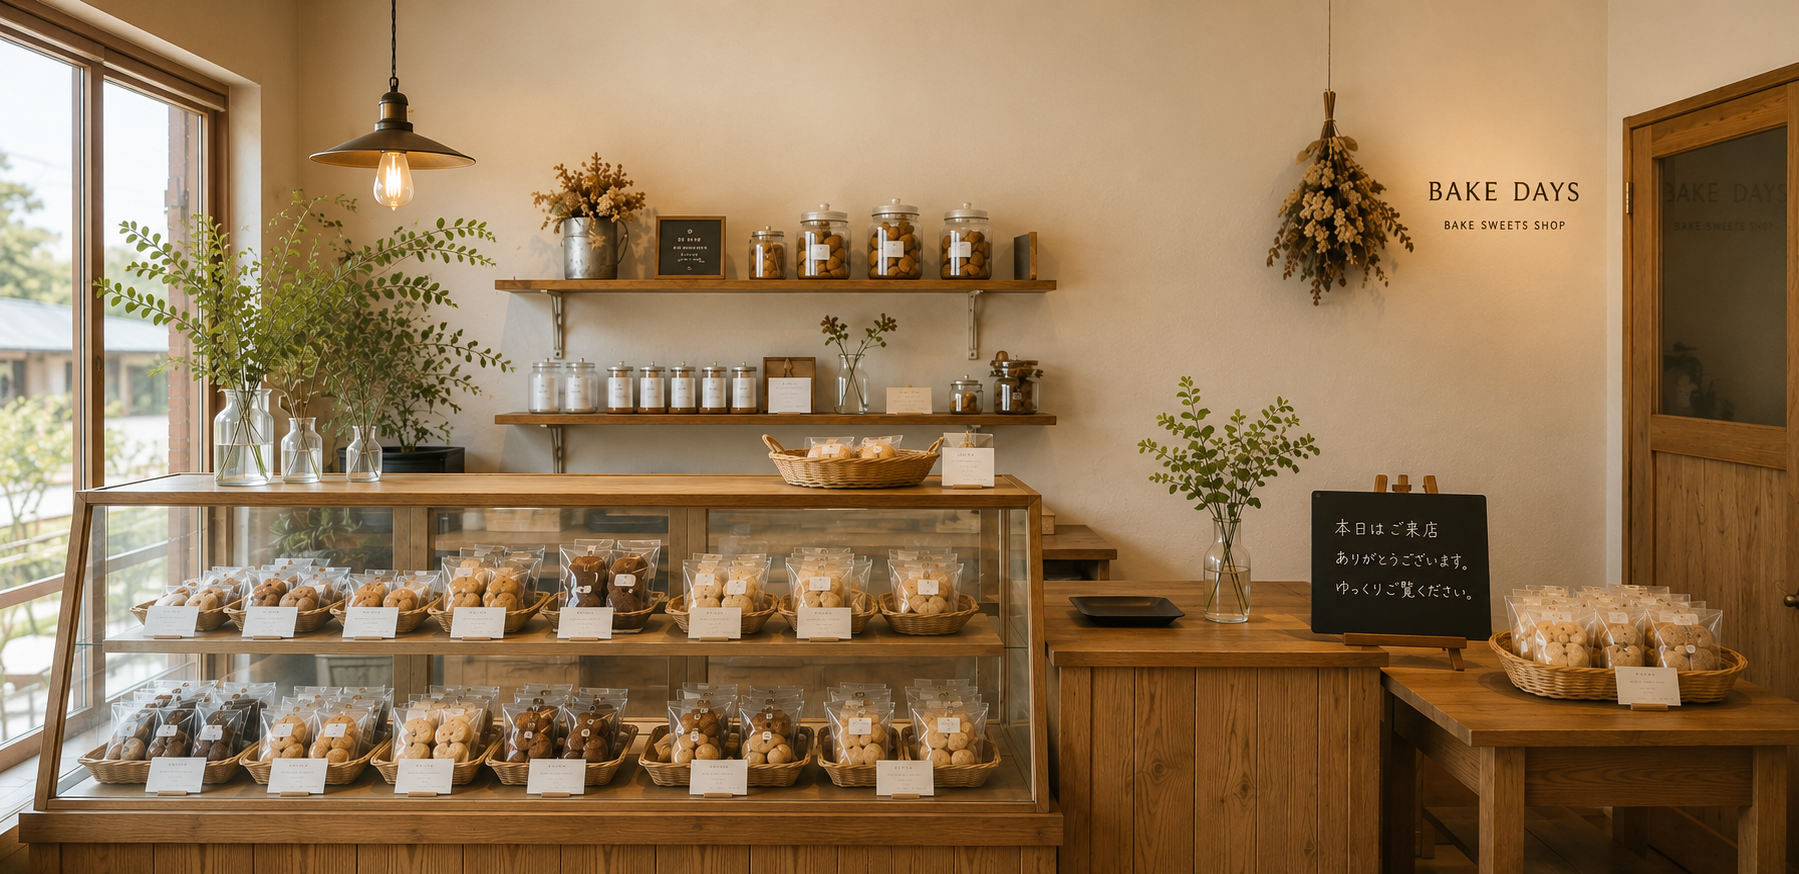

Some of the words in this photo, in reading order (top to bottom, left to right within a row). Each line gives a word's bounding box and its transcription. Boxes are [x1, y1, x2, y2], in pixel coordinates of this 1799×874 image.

[1429, 181, 1498, 202] BAKE
[1513, 181, 1579, 202] DAYS
[1733, 183, 1787, 204] DAYS
[1444, 220, 1475, 230] BAKE
[1481, 220, 1528, 230] SWEETS
[1534, 220, 1565, 230] SHOP
[1674, 221, 1701, 231] BAKE
[1335, 518, 1438, 538] 本日はご来店
[1335, 550, 1468, 571] ありがとうございます。
[1335, 580, 1472, 601] ゆっくりご覧ください。
